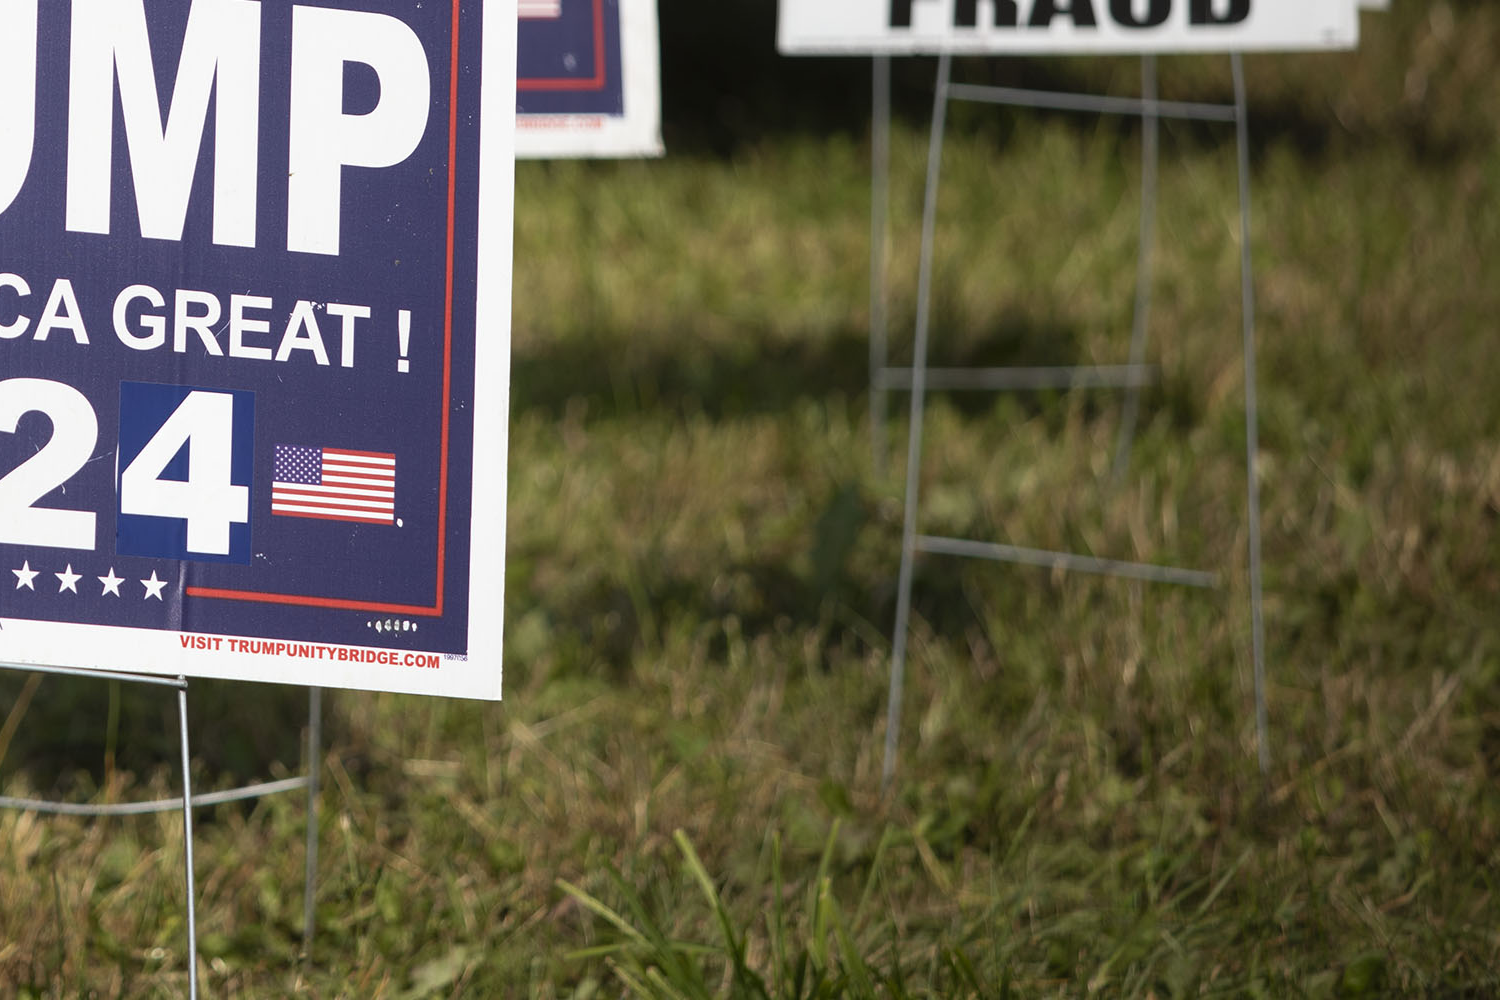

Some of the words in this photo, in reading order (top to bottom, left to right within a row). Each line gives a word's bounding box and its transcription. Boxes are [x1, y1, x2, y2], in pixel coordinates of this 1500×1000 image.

[112, 284, 371, 368] GREAT
[179, 634, 223, 652] VISIT
[227, 639, 440, 669] TRUMPUNITYBRIDGE.COM
